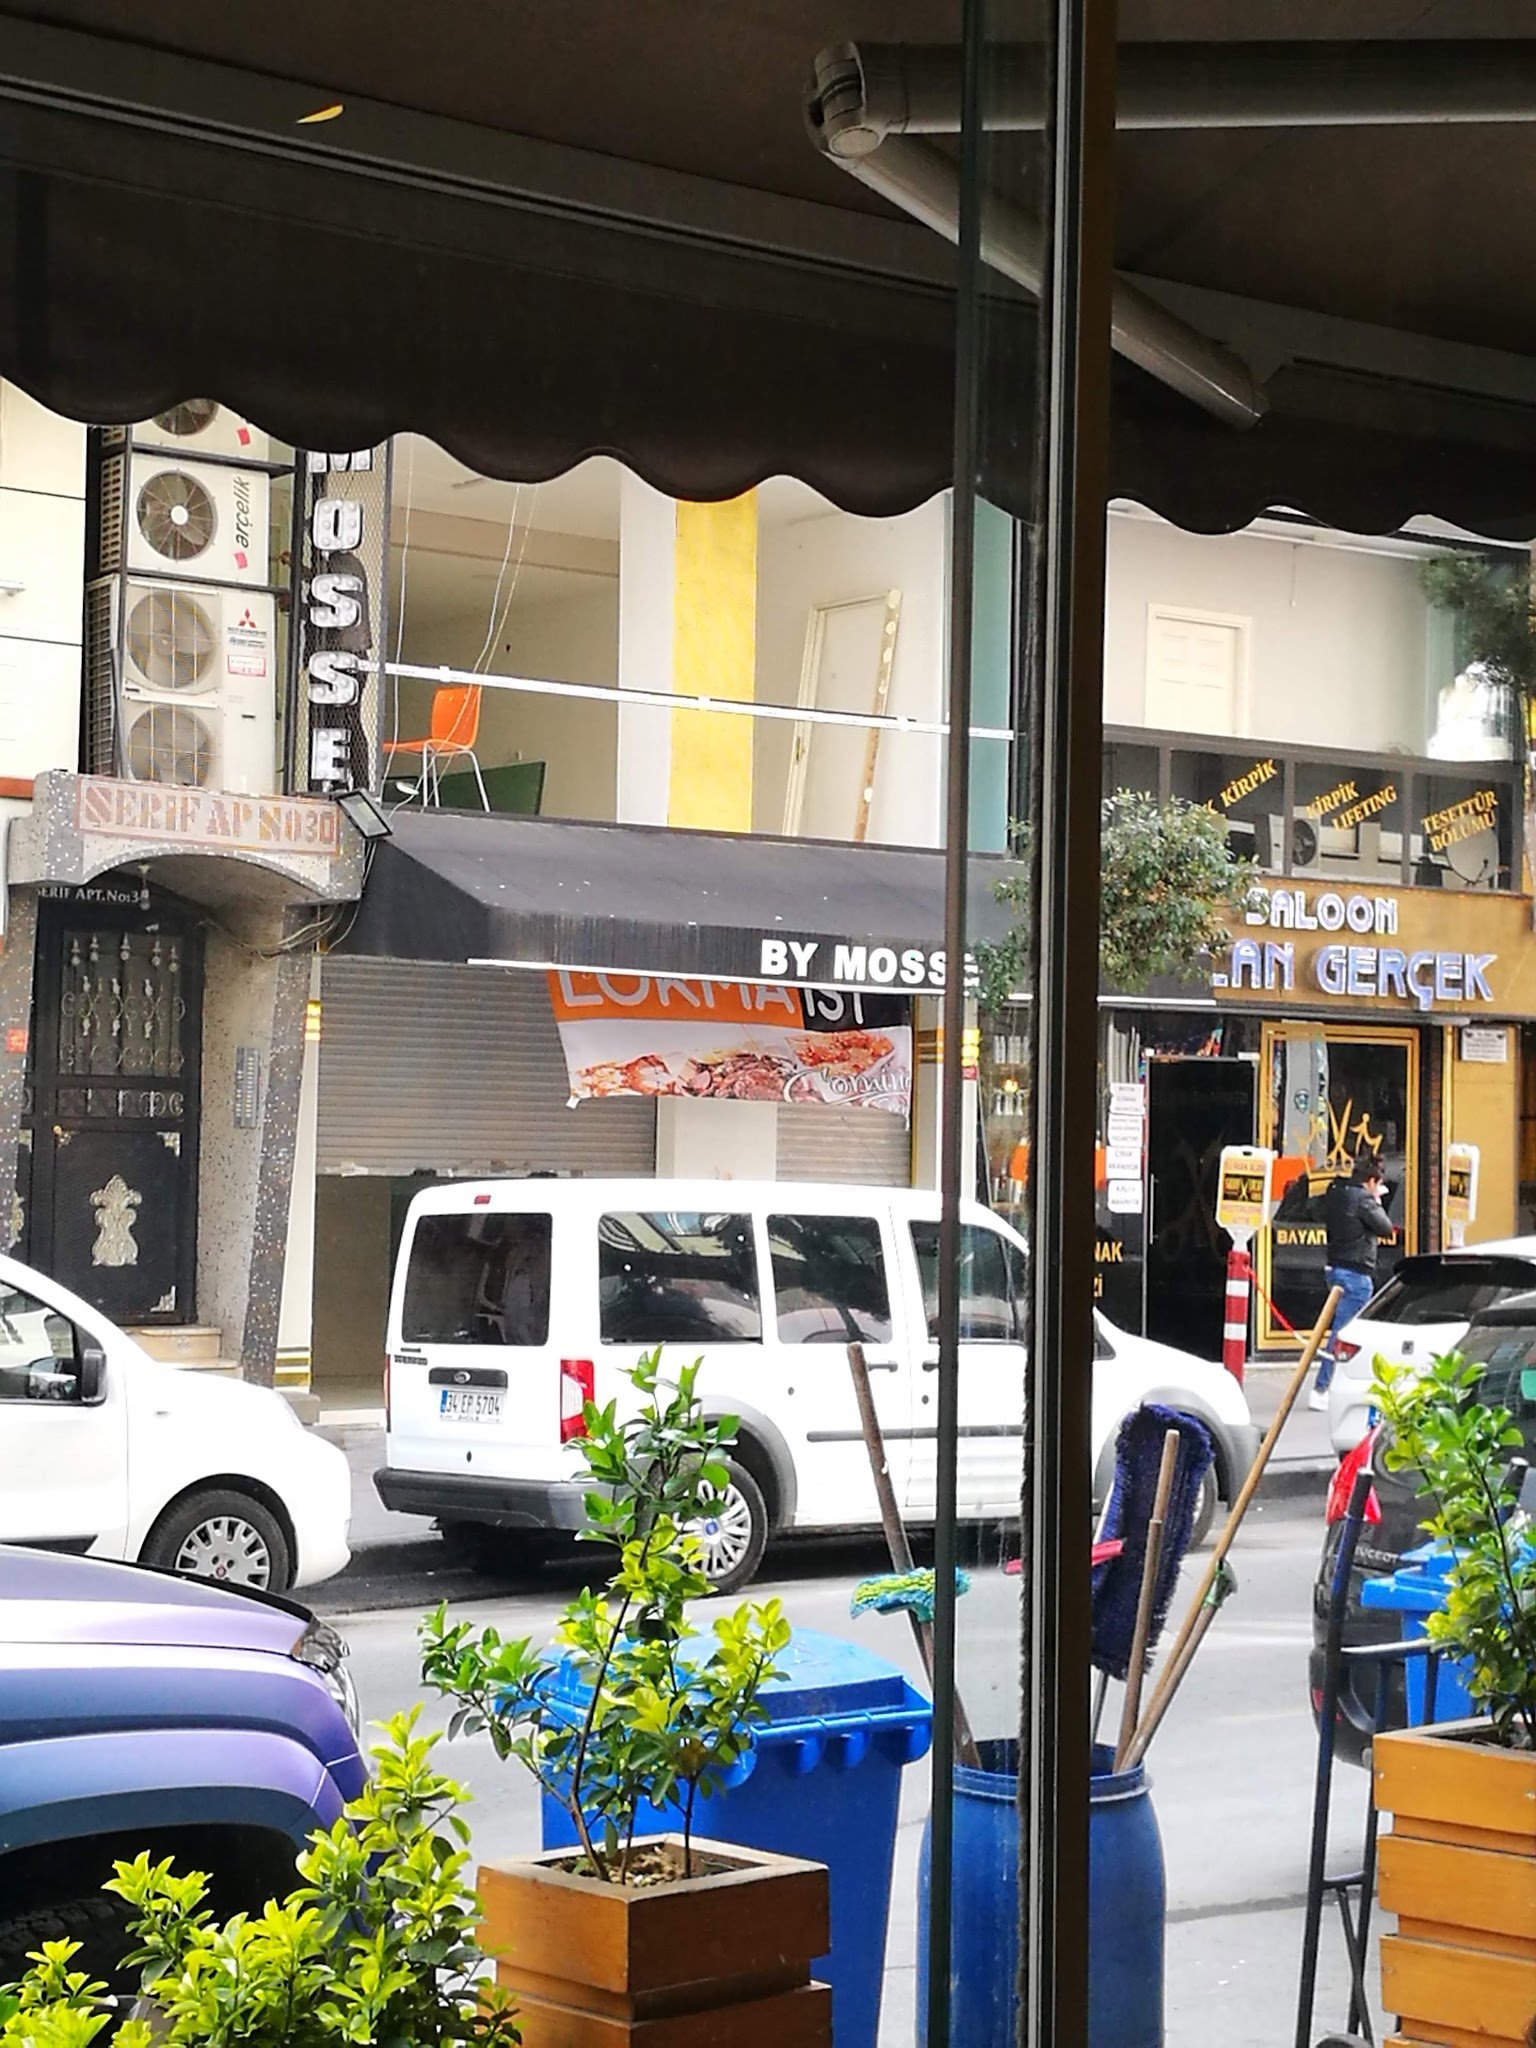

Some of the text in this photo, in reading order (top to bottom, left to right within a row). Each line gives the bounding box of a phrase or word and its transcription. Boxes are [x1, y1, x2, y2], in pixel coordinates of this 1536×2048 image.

[233, 476, 253, 548] arçelik
[1245, 886, 1399, 936] SALOON
[760, 938, 820, 977] BY
[1315, 944, 1498, 1011] GERÇEK
[783, 1066, 910, 1104] Comin
[446, 1393, 457, 1413] 34
